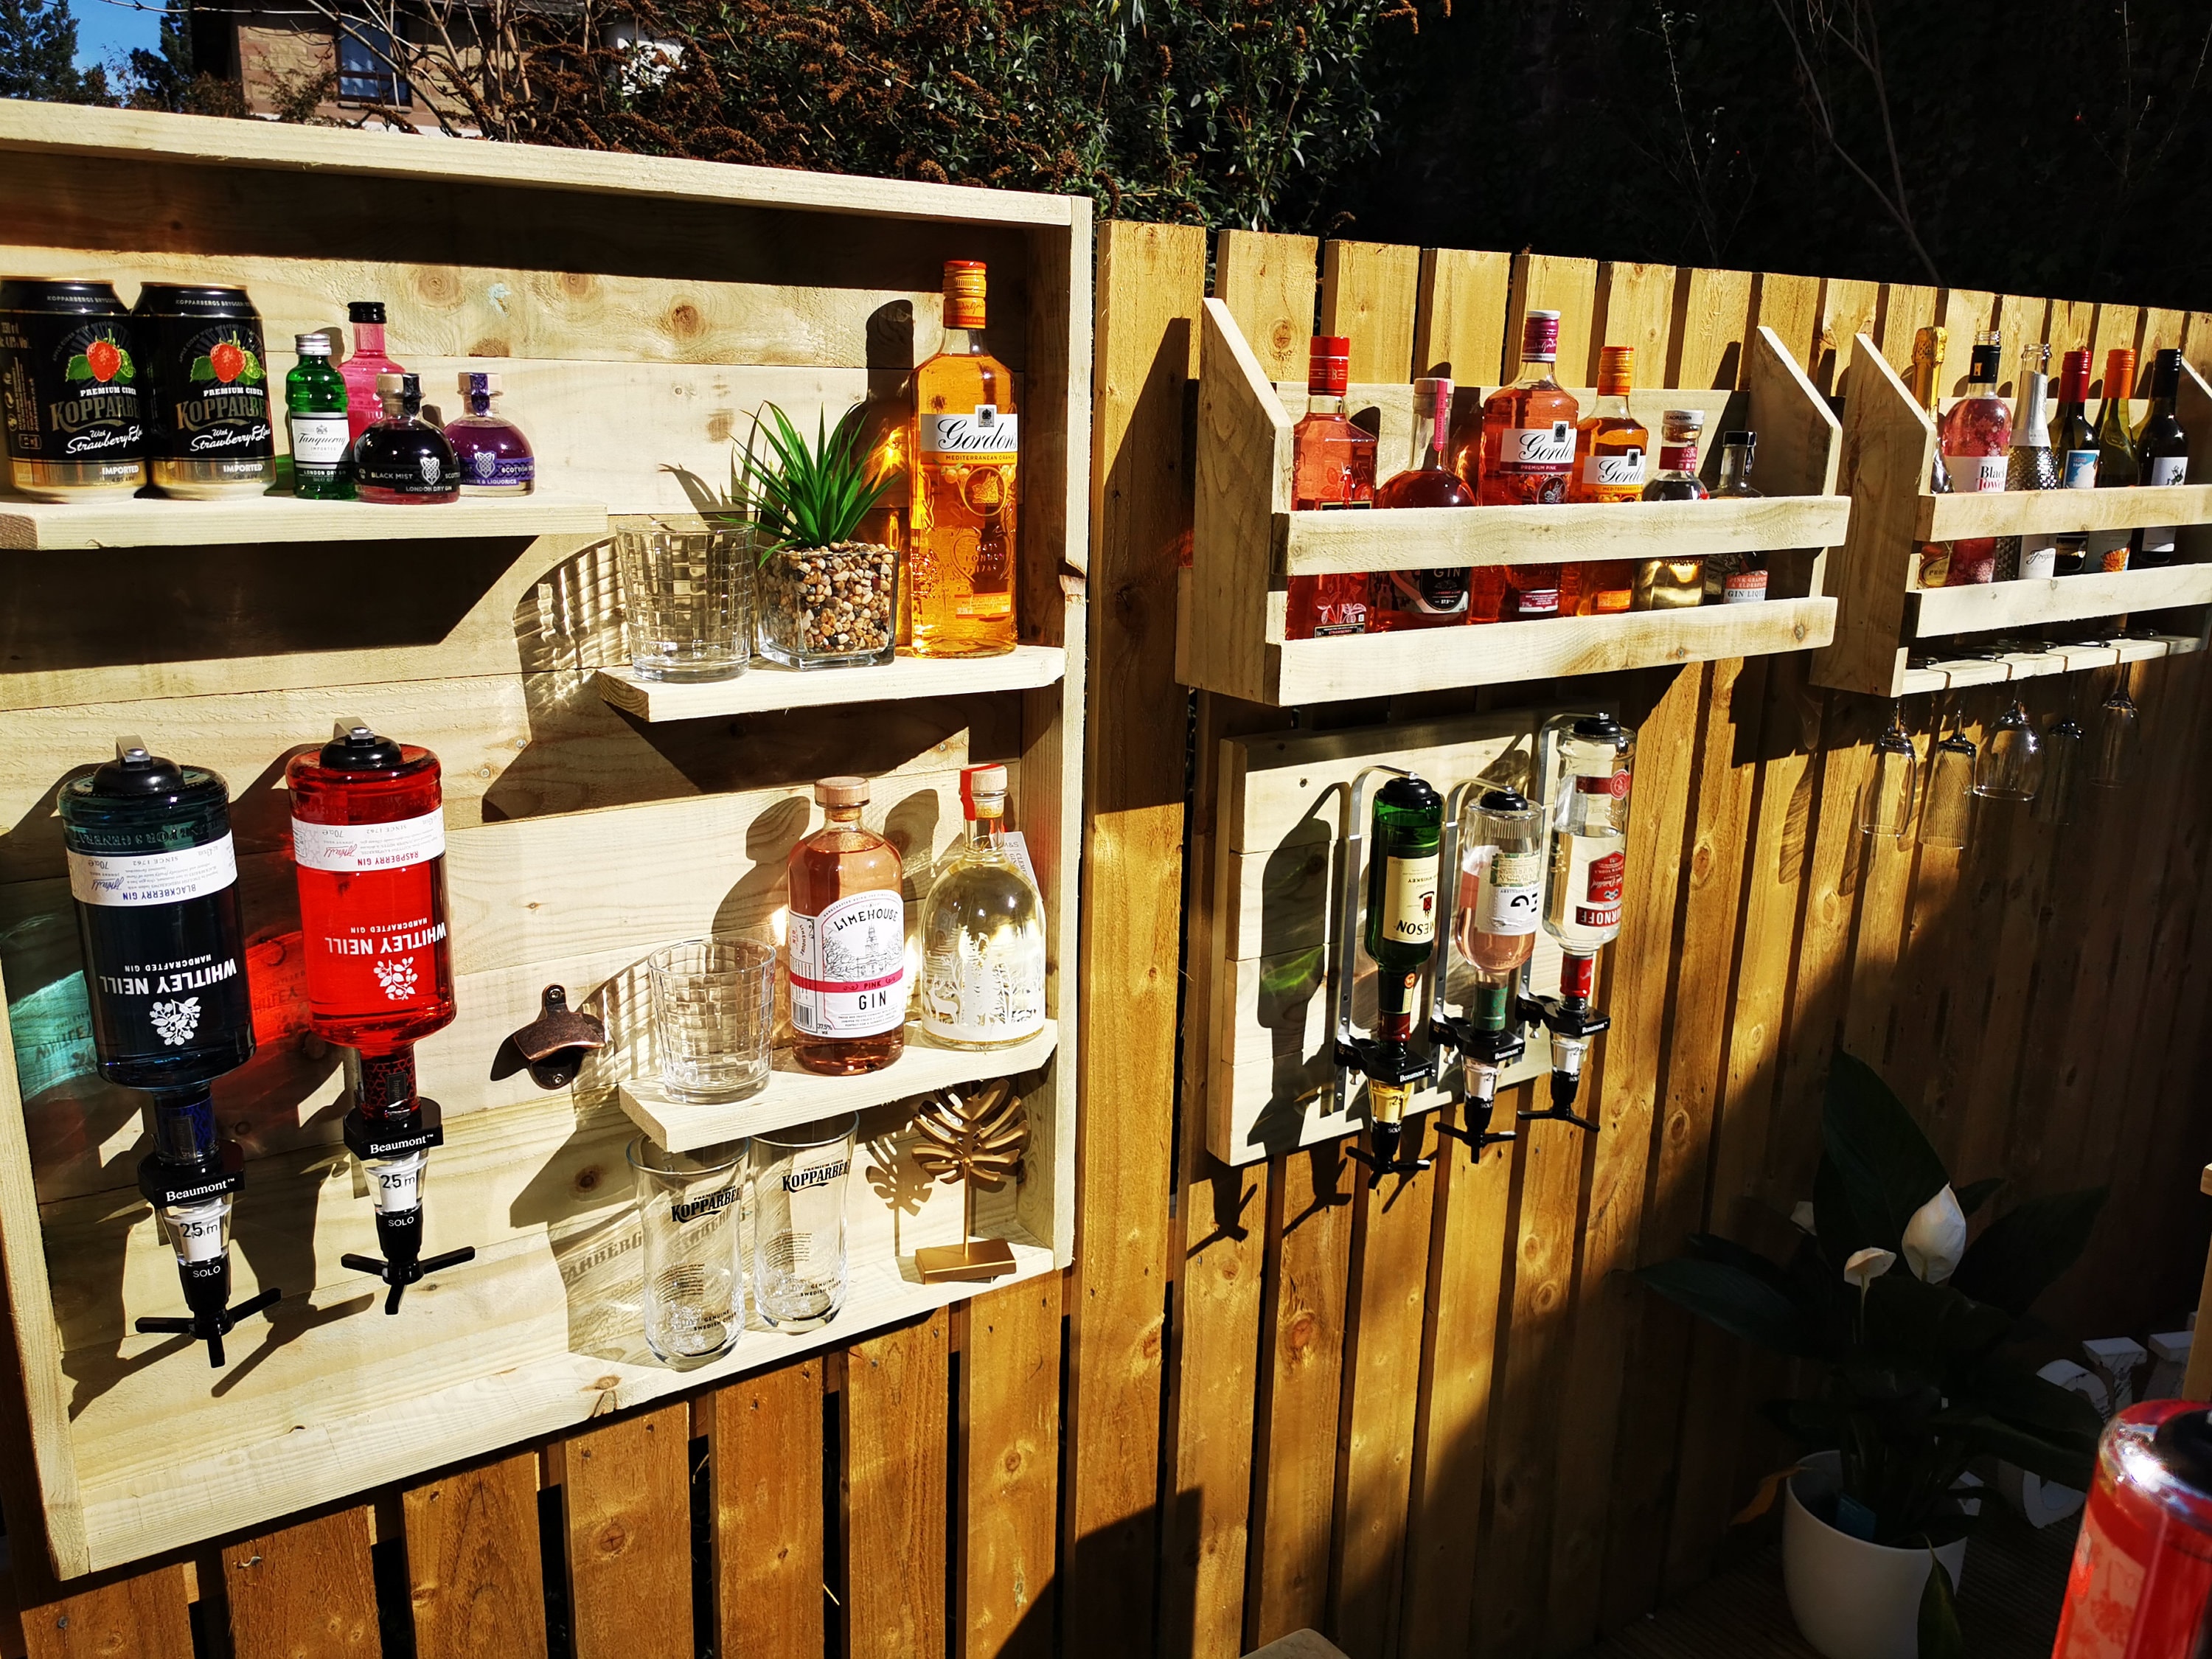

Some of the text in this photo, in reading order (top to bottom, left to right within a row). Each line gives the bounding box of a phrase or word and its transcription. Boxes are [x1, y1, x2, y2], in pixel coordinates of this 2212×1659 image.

[80, 386, 120, 397] PREMIUM
[204, 387, 243, 397] PREMIUM
[89, 430, 106, 438] With
[212, 428, 228, 437] With
[937, 418, 1018, 450] Gordon's
[298, 433, 346, 446] Tanqueray
[102, 465, 139, 475] IMPORTED
[223, 464, 263, 473] IMPORTED
[1433, 568, 1461, 578] GIN
[153, 856, 178, 868] SINCE
[375, 851, 419, 865] RASPBERRY
[122, 884, 196, 901] BLACKBERRY GIN
[369, 917, 428, 933] HANDCRAFTED
[833, 908, 898, 931] LIMEHOUSE
[324, 922, 447, 955] WHITLEY NEILL
[125, 953, 212, 973] HANDCRAFTED GIN
[100, 958, 237, 995] WHITLEY NEILL
[863, 981, 882, 990] PINK
[858, 990, 886, 1010] GIN
[804, 1164, 830, 1172] PREMIUM
[694, 1189, 722, 1201] PREMIUM
[388, 1216, 414, 1227] SOLO
[192, 1265, 221, 1279] SOLO
[800, 1279, 841, 1297] SWEDISH CIDER
[810, 1277, 835, 1289] GENUINE
[703, 1309, 729, 1322] GENUINE
[694, 1321, 721, 1332] SWEDISH
